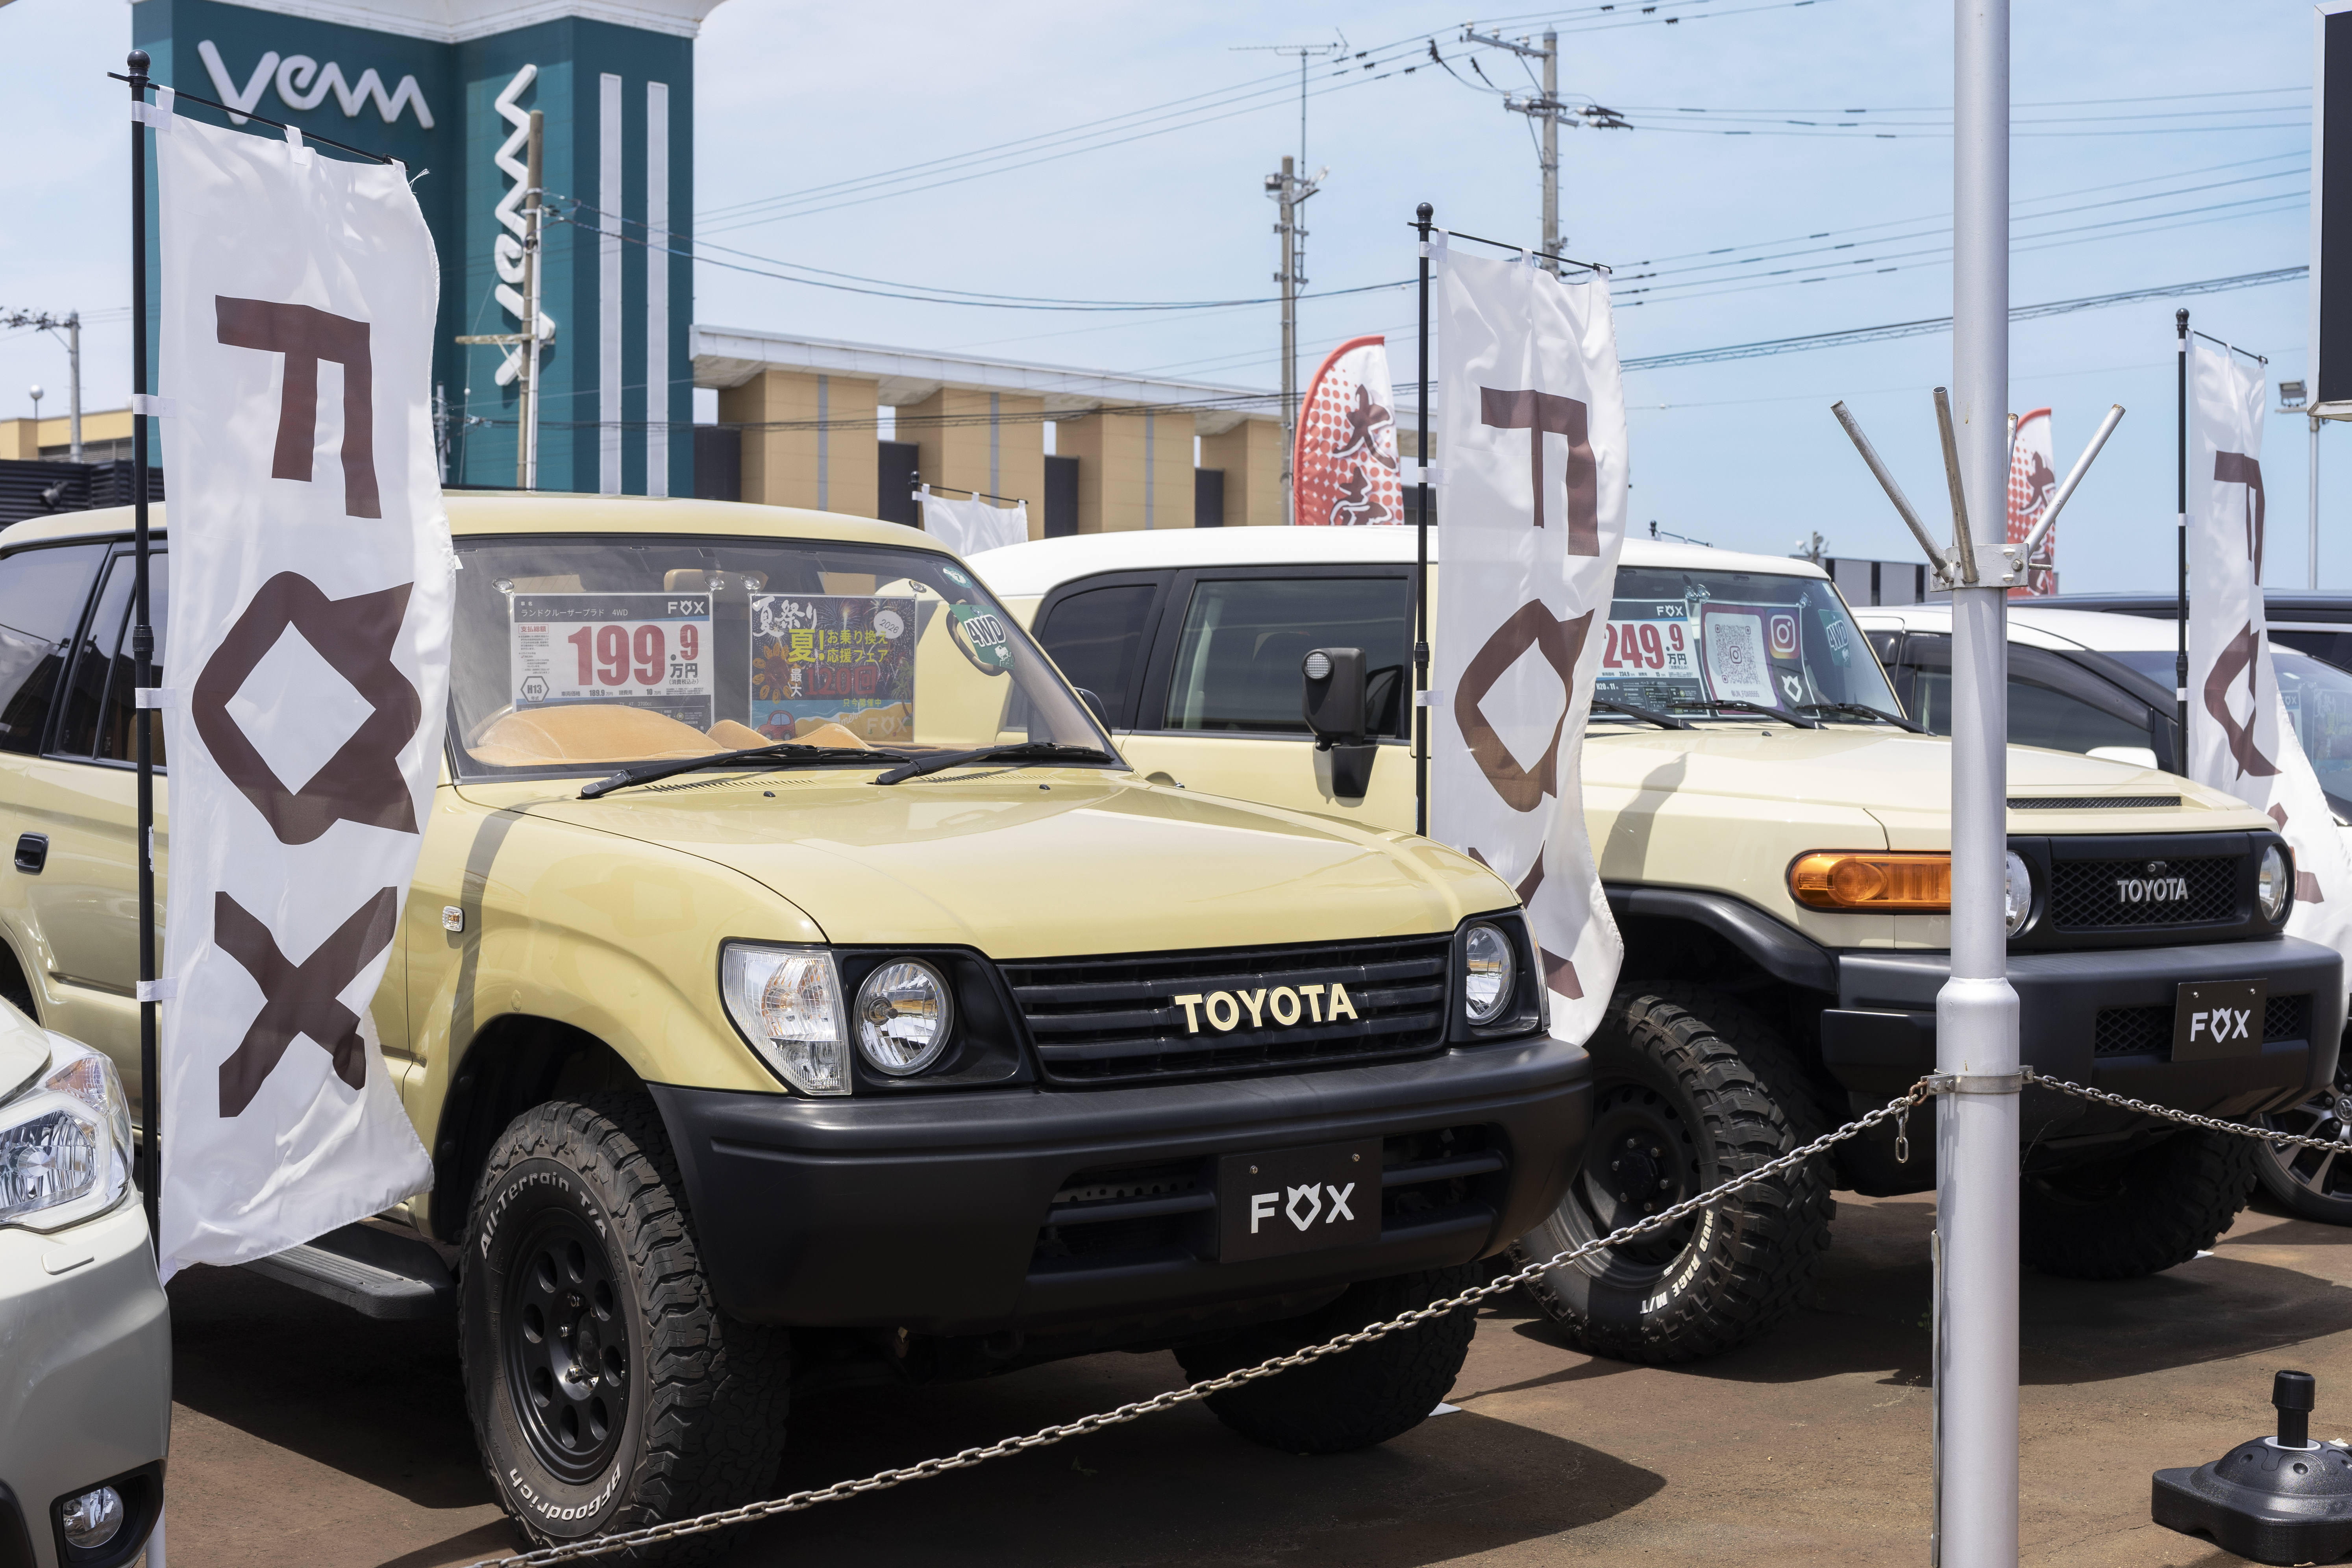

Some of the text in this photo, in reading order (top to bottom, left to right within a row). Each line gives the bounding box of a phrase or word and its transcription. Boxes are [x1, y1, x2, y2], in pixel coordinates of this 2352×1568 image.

[521, 609, 604, 617] ランドクルーザープラド
[668, 600, 704, 615] FOX
[752, 595, 817, 638] 夏祭り
[1656, 605, 1684, 617] FOX
[827, 630, 888, 645] お乗り換え
[879, 618, 899, 634] 2026
[964, 615, 1006, 647] 4WD
[1826, 620, 1849, 651] 4WD
[827, 648, 888, 663] 応援フェア
[1667, 653, 1687, 665] 万円
[670, 663, 698, 678] 万円
[790, 668, 802, 697] 最大
[805, 666, 878, 695] 120回
[527, 685, 542, 694] H13
[843, 698, 881, 707] 只今開催中
[867, 716, 908, 735] FOX
[2117, 877, 2189, 903] TOYOTA
[1174, 983, 1358, 1033] TOYOTA
[2190, 1007, 2251, 1043] FOX
[480, 1172, 570, 1260] All-Terrain
[1251, 1181, 1355, 1234] FOX
[1640, 1209, 1714, 1314] MUD RAGE M/T
[509, 1462, 621, 1521] BFGoodrich
